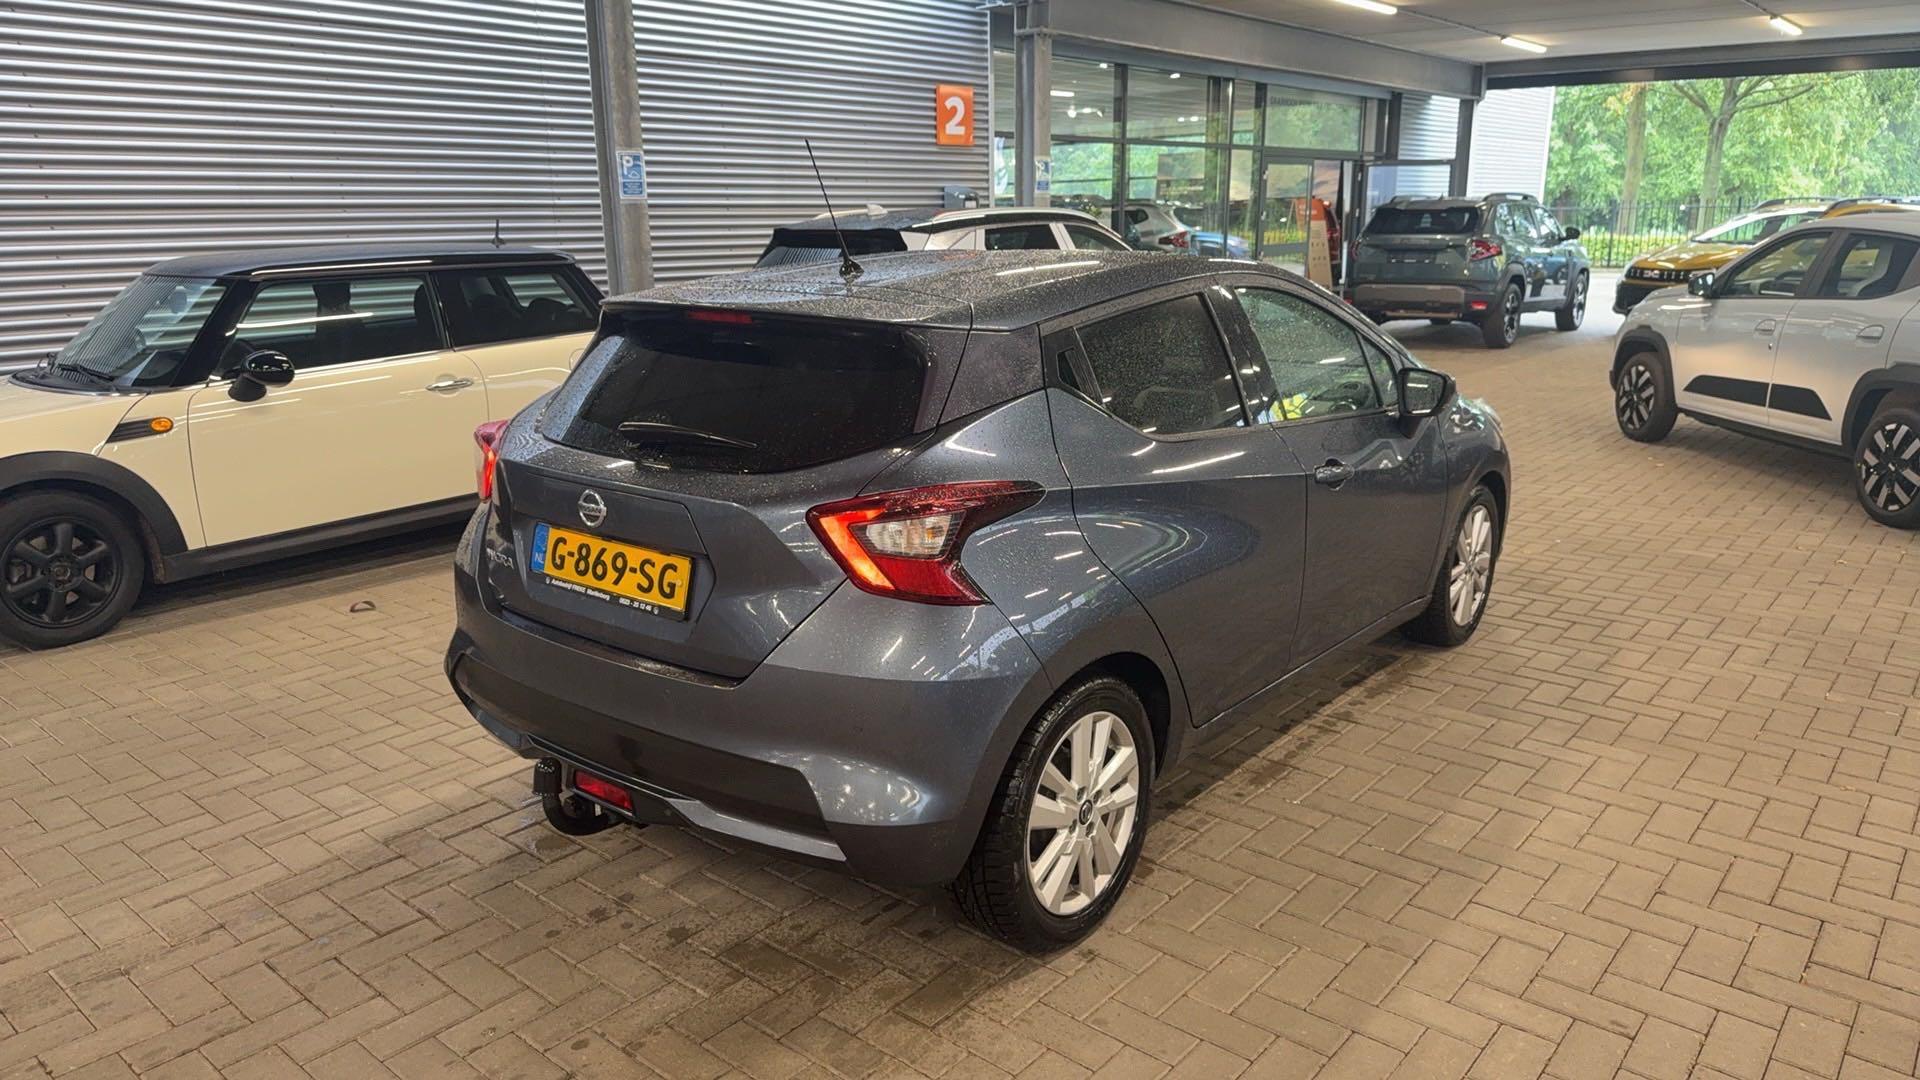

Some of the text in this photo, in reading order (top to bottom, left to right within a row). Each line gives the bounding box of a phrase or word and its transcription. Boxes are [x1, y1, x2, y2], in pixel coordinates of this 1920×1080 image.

[944, 95, 966, 136] 2
[534, 553, 544, 564] NL
[551, 536, 679, 600] G-869-SG
